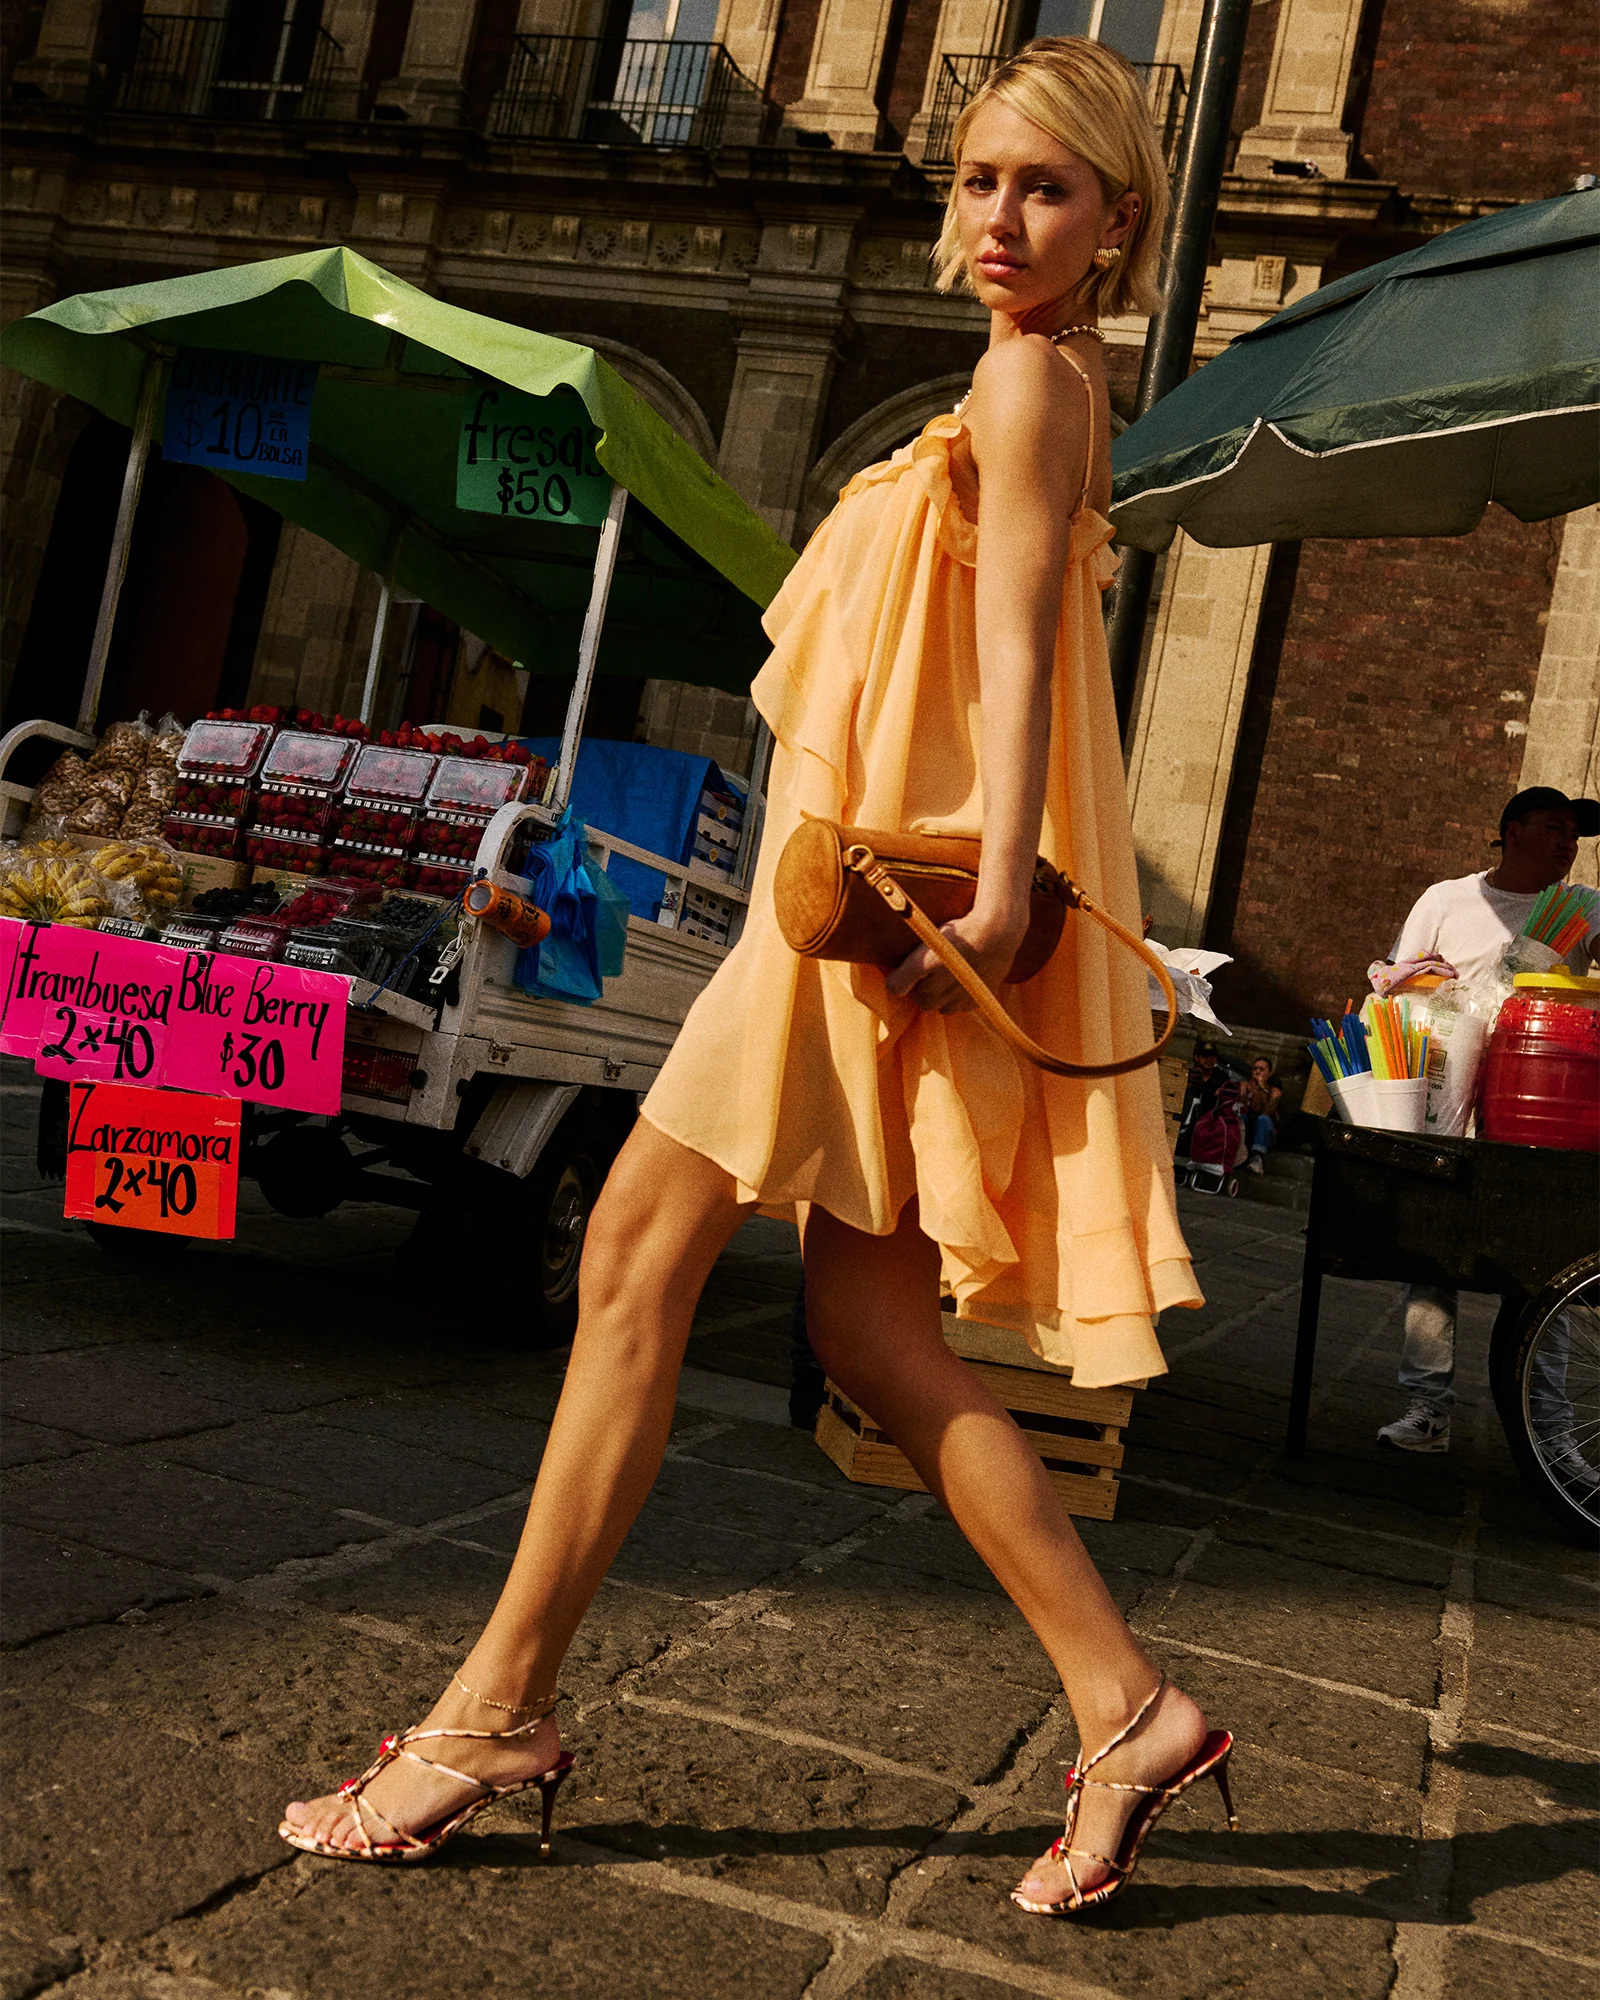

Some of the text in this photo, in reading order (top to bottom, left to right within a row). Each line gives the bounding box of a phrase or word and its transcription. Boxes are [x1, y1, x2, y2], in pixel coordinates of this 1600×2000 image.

[269, 427, 288, 443] LA
[464, 389, 606, 477] fresas
[496, 466, 572, 517] $50
[177, 951, 331, 1061] Blue Berry
[219, 1031, 286, 1091] $30
[68, 1083, 233, 1165] Zarzamora
